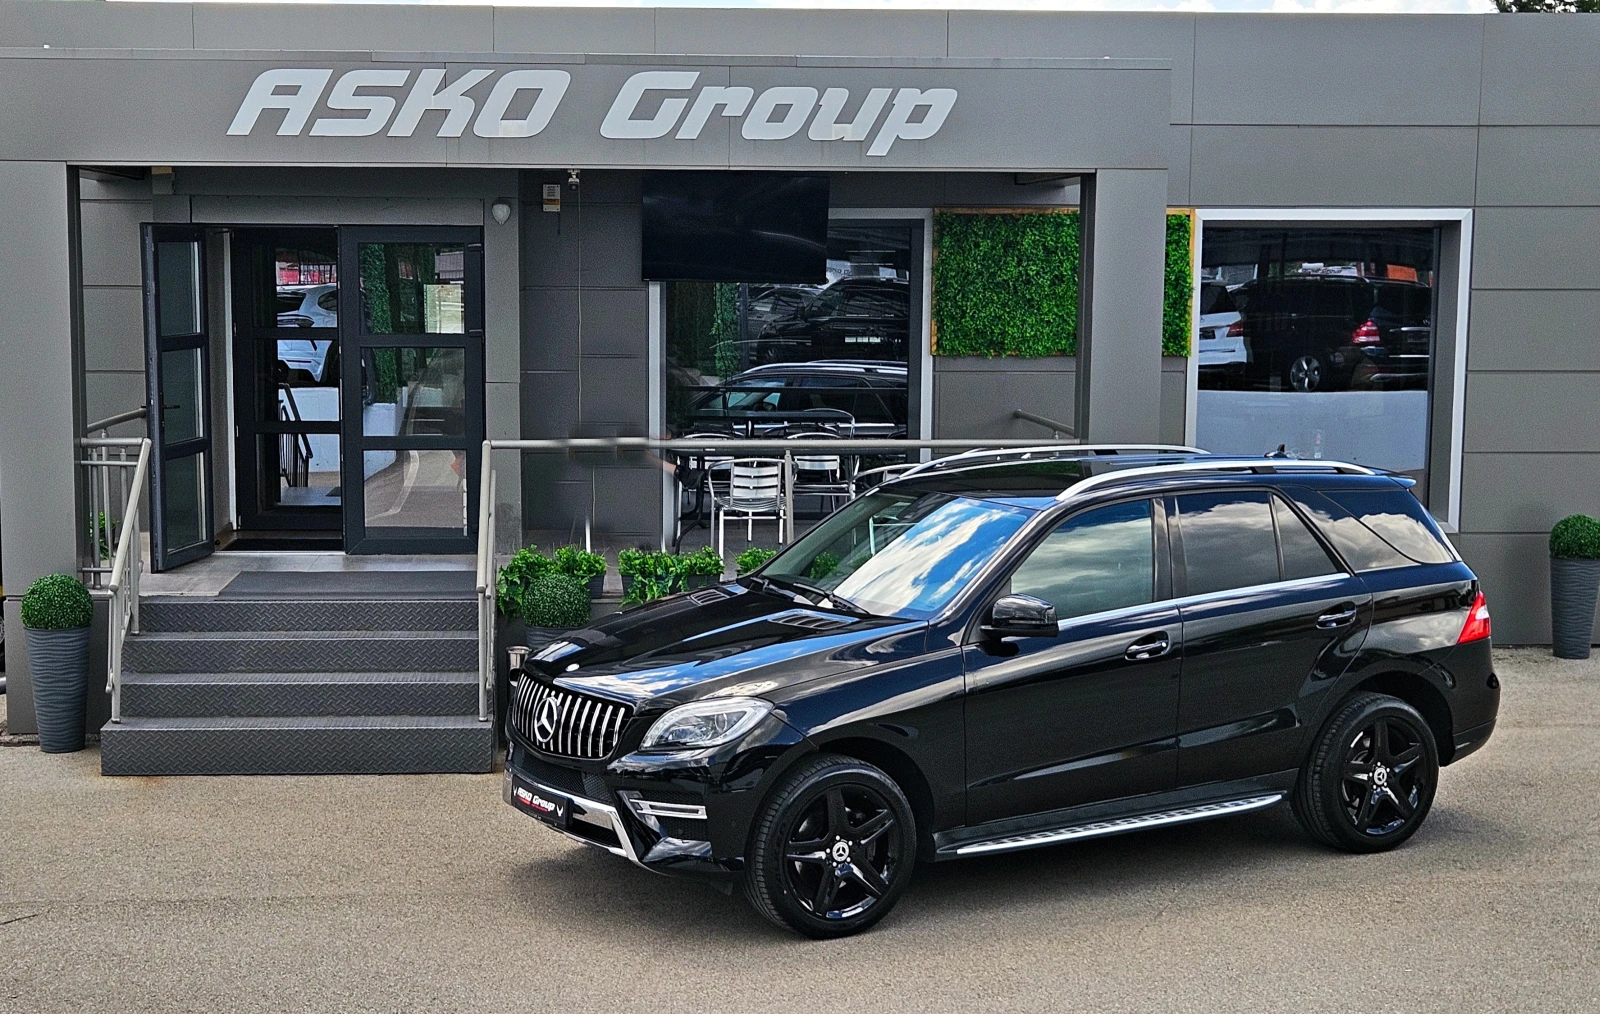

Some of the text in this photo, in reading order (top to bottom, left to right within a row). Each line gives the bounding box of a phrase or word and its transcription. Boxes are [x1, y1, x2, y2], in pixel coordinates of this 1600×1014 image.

[226, 68, 958, 157] ASKO Group
[532, 795, 556, 812] Group
